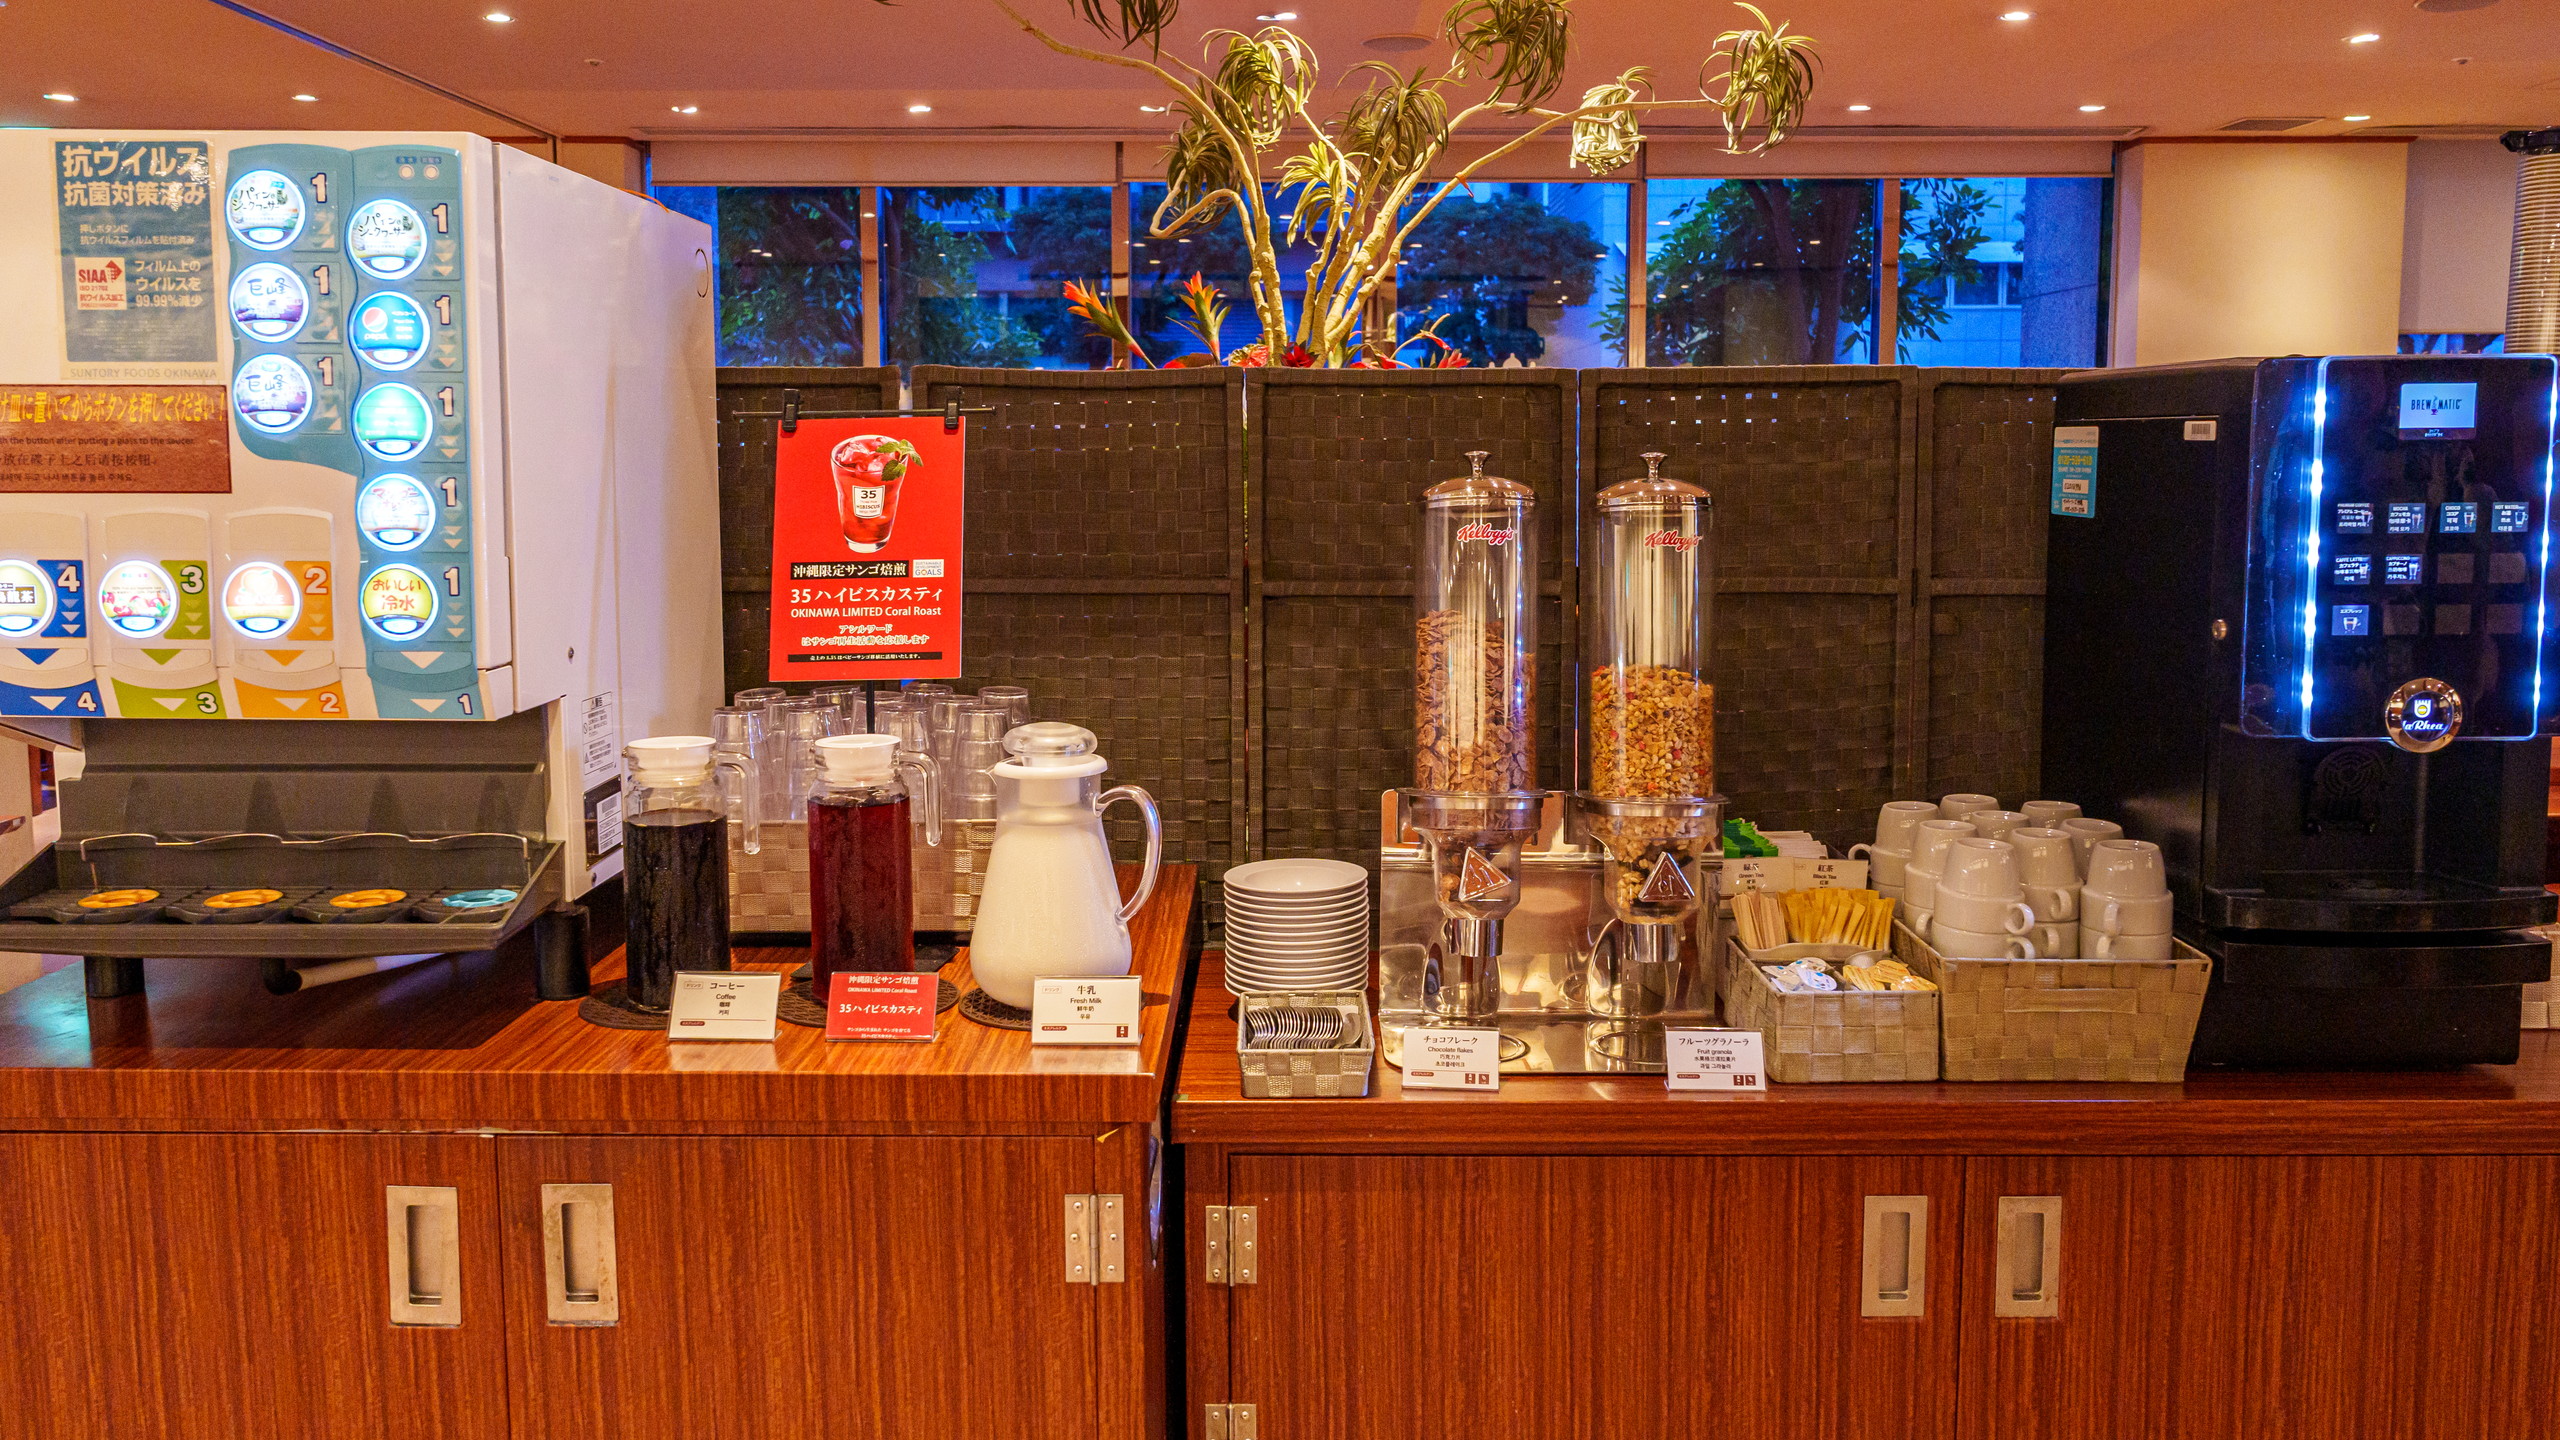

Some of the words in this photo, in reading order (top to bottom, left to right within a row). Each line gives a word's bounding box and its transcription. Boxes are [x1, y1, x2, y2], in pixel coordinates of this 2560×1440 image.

[62, 145, 204, 178] 抗ウイルス
[63, 181, 207, 207] 抗菌対策済み
[310, 172, 328, 204] 1
[432, 203, 449, 234] 1
[78, 269, 108, 283] SIAA
[134, 260, 201, 273] フィルム上の
[135, 277, 201, 292] ウイルスを
[313, 264, 330, 296] 1
[435, 294, 451, 326] 1
[70, 368, 120, 378] SUNTORY
[124, 368, 161, 378] FOODS
[164, 368, 218, 378] OKINAWA
[317, 356, 334, 386] 1
[437, 386, 454, 417] 1
[10, 437, 24, 445] the
[441, 476, 457, 507] 1
[860, 490, 877, 499] 35
[1457, 522, 1517, 545] Kellogg's
[1644, 529, 1703, 552] Kellogg's
[57, 564, 81, 593] 4
[180, 565, 205, 595] 3
[304, 566, 329, 596] 2
[443, 566, 460, 597] 1
[793, 563, 907, 578] 沖縄限定サンゴ焙煎
[915, 569, 942, 577] GOALS
[372, 578, 422, 592] おいしい
[381, 595, 415, 611] 冷水
[790, 608, 840, 618] OKINAWA
[842, 607, 883, 618] LIMITED
[885, 606, 911, 617] Coral
[913, 606, 942, 616] Roast
[77, 691, 98, 712] 4
[196, 691, 219, 714] 3
[320, 692, 342, 714] 2
[457, 693, 473, 715] 1
[710, 982, 745, 990] コーヒー
[1077, 985, 1097, 995] 牛乳
[1423, 1035, 1478, 1045] チョコフレーク
[1678, 1038, 1750, 1047] フルーツグラノーラ
